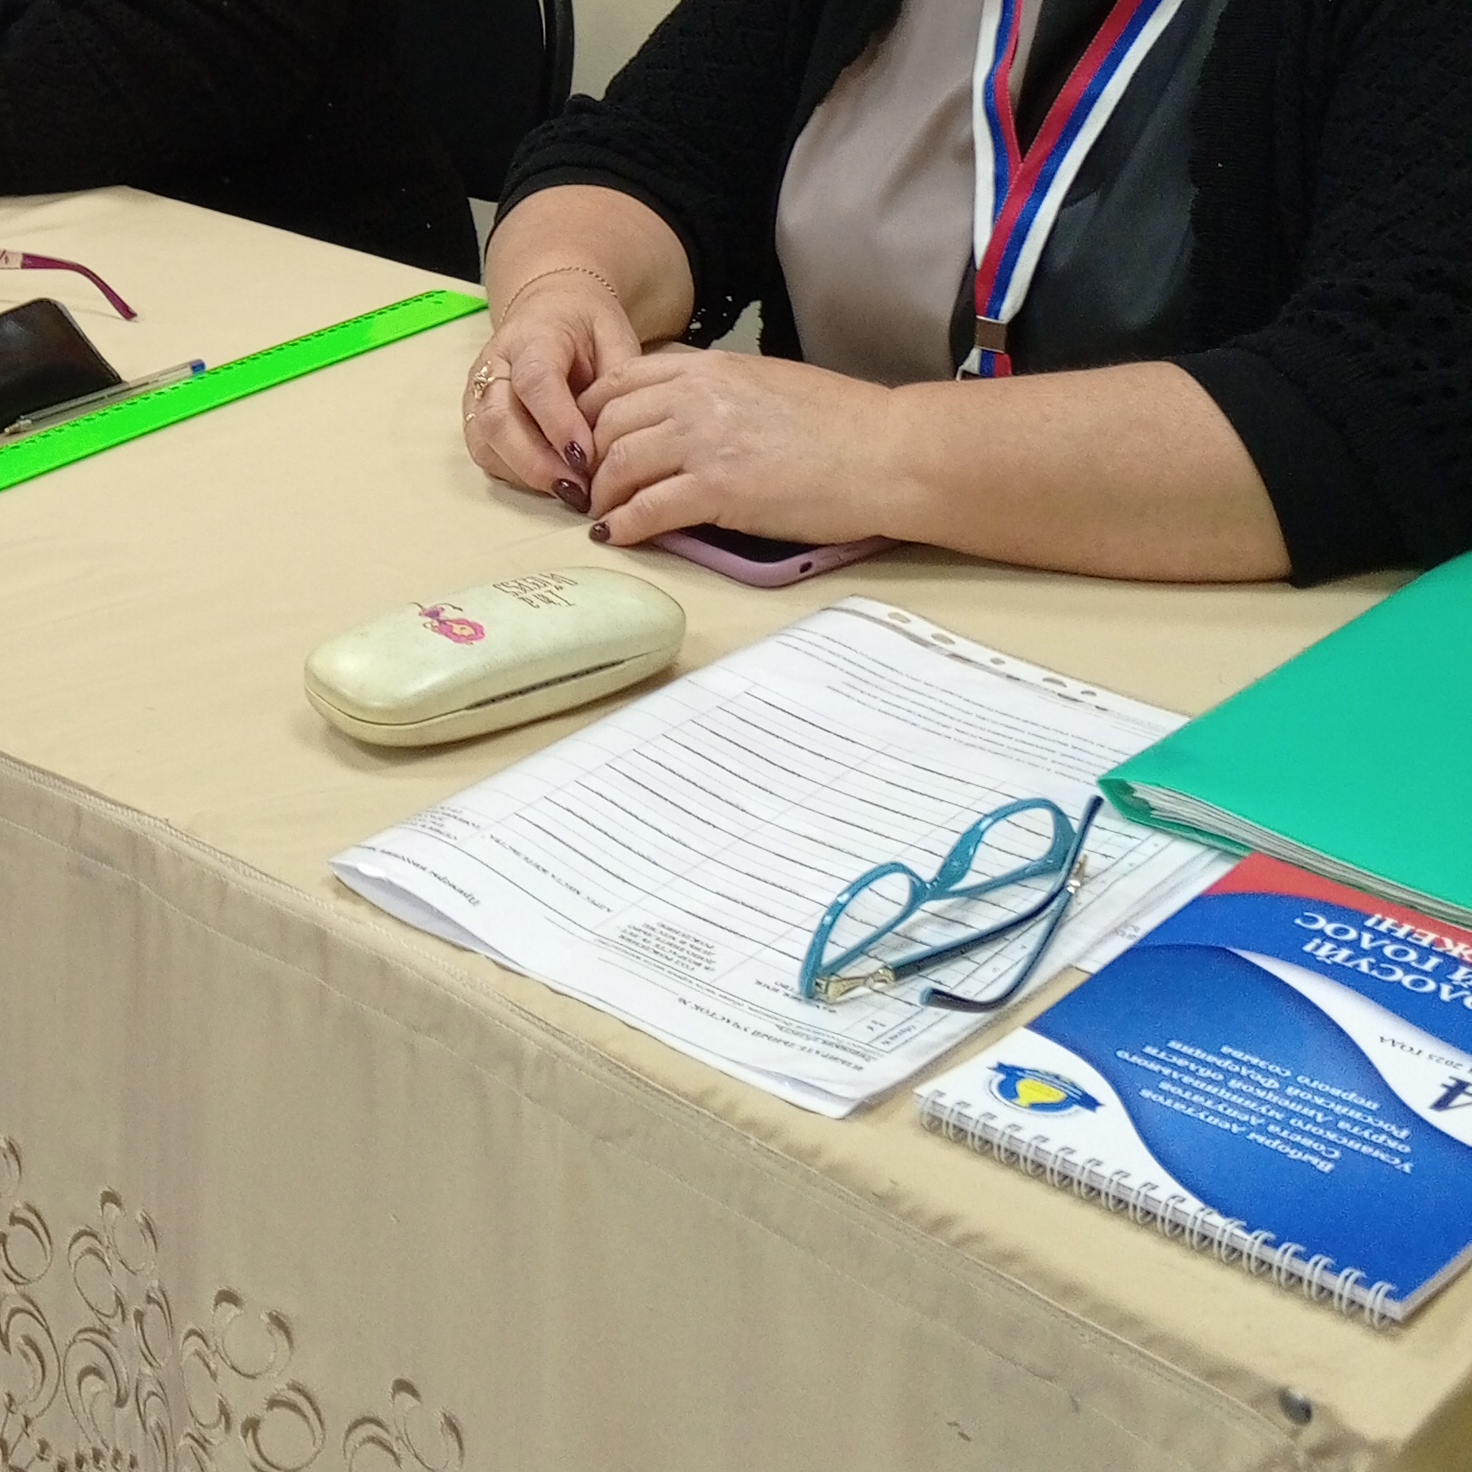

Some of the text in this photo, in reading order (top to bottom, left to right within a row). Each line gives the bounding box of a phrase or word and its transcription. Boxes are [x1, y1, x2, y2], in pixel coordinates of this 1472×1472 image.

[1293, 911, 1443, 973] ГОЛОС
[1379, 1035, 1423, 1056] ГОДА
[1427, 1053, 1463, 1070] 2025
[1266, 1123, 1342, 1160] Совета
